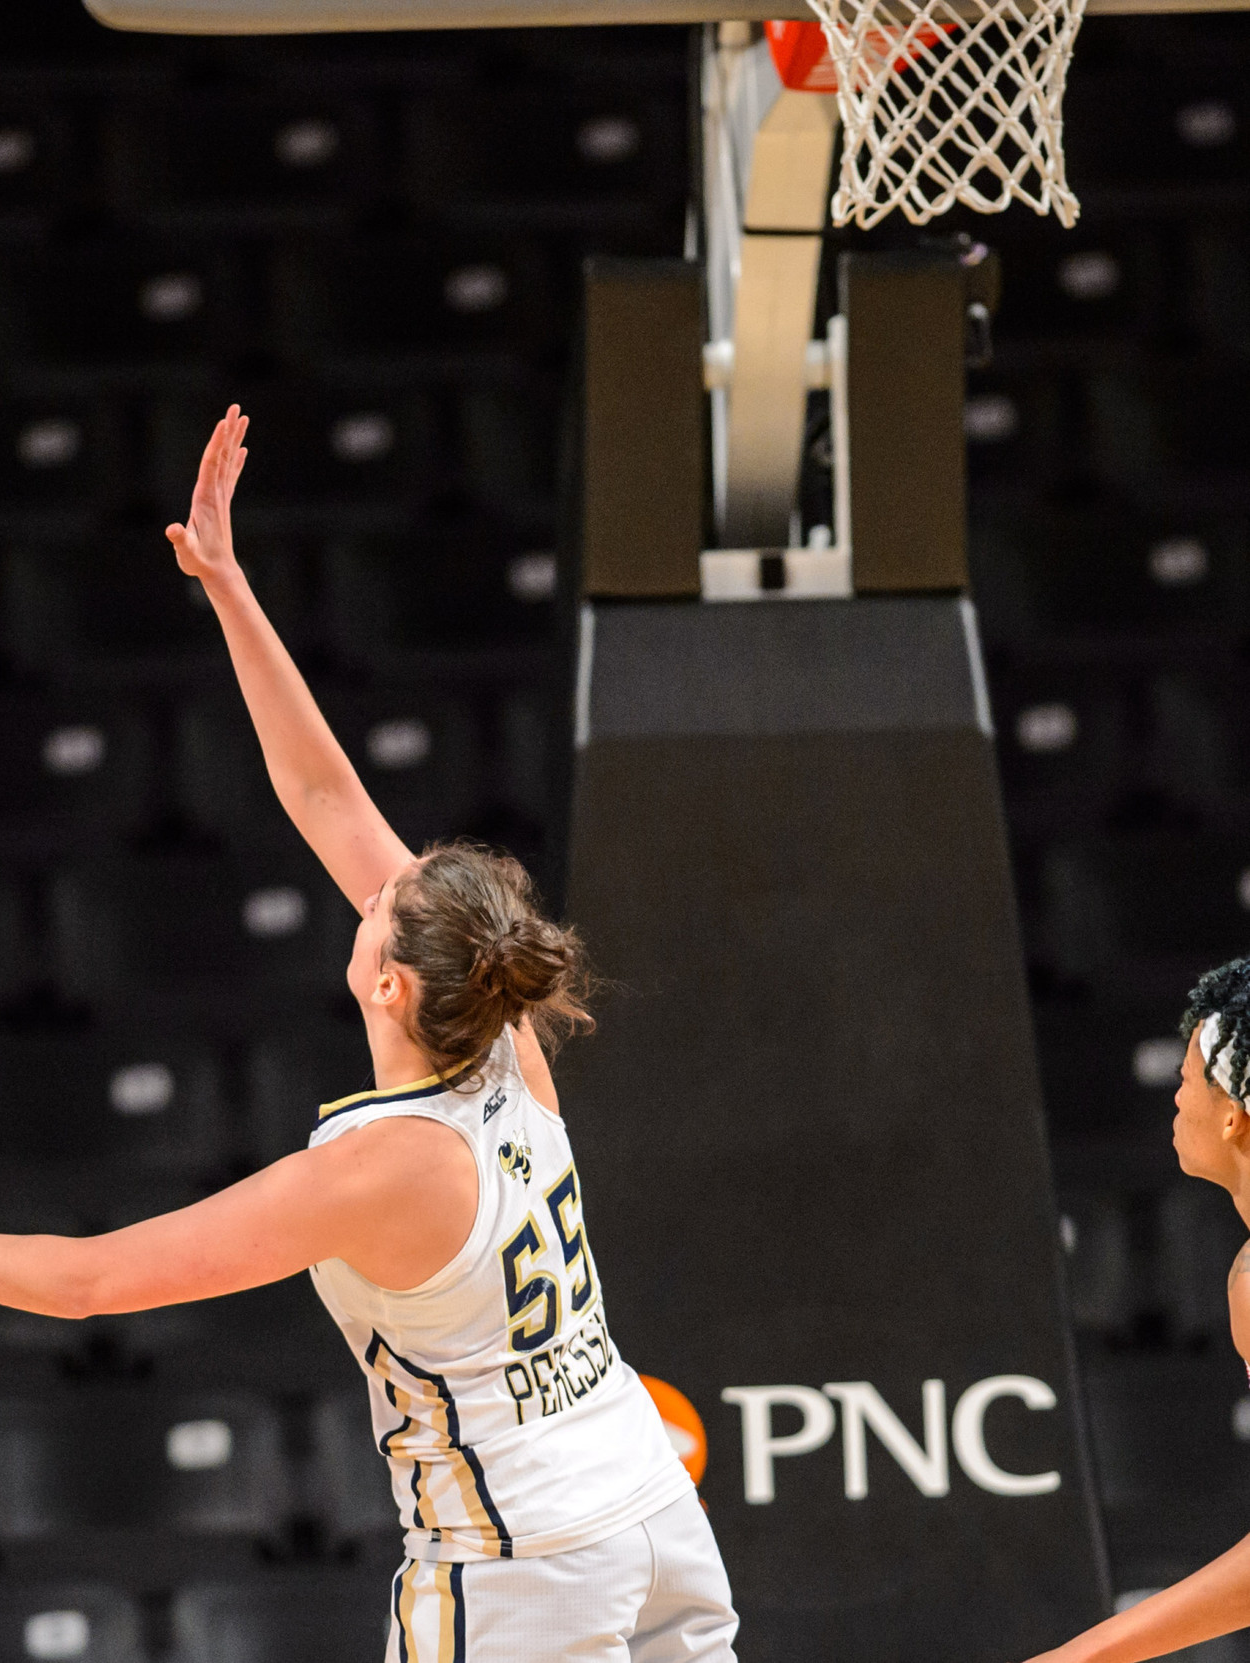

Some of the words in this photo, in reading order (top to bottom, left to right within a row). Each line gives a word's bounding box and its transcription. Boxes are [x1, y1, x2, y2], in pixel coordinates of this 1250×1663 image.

[483, 1086, 507, 1125] ACC
[497, 1160, 598, 1354] 55
[721, 1374, 1061, 1505] PNC
